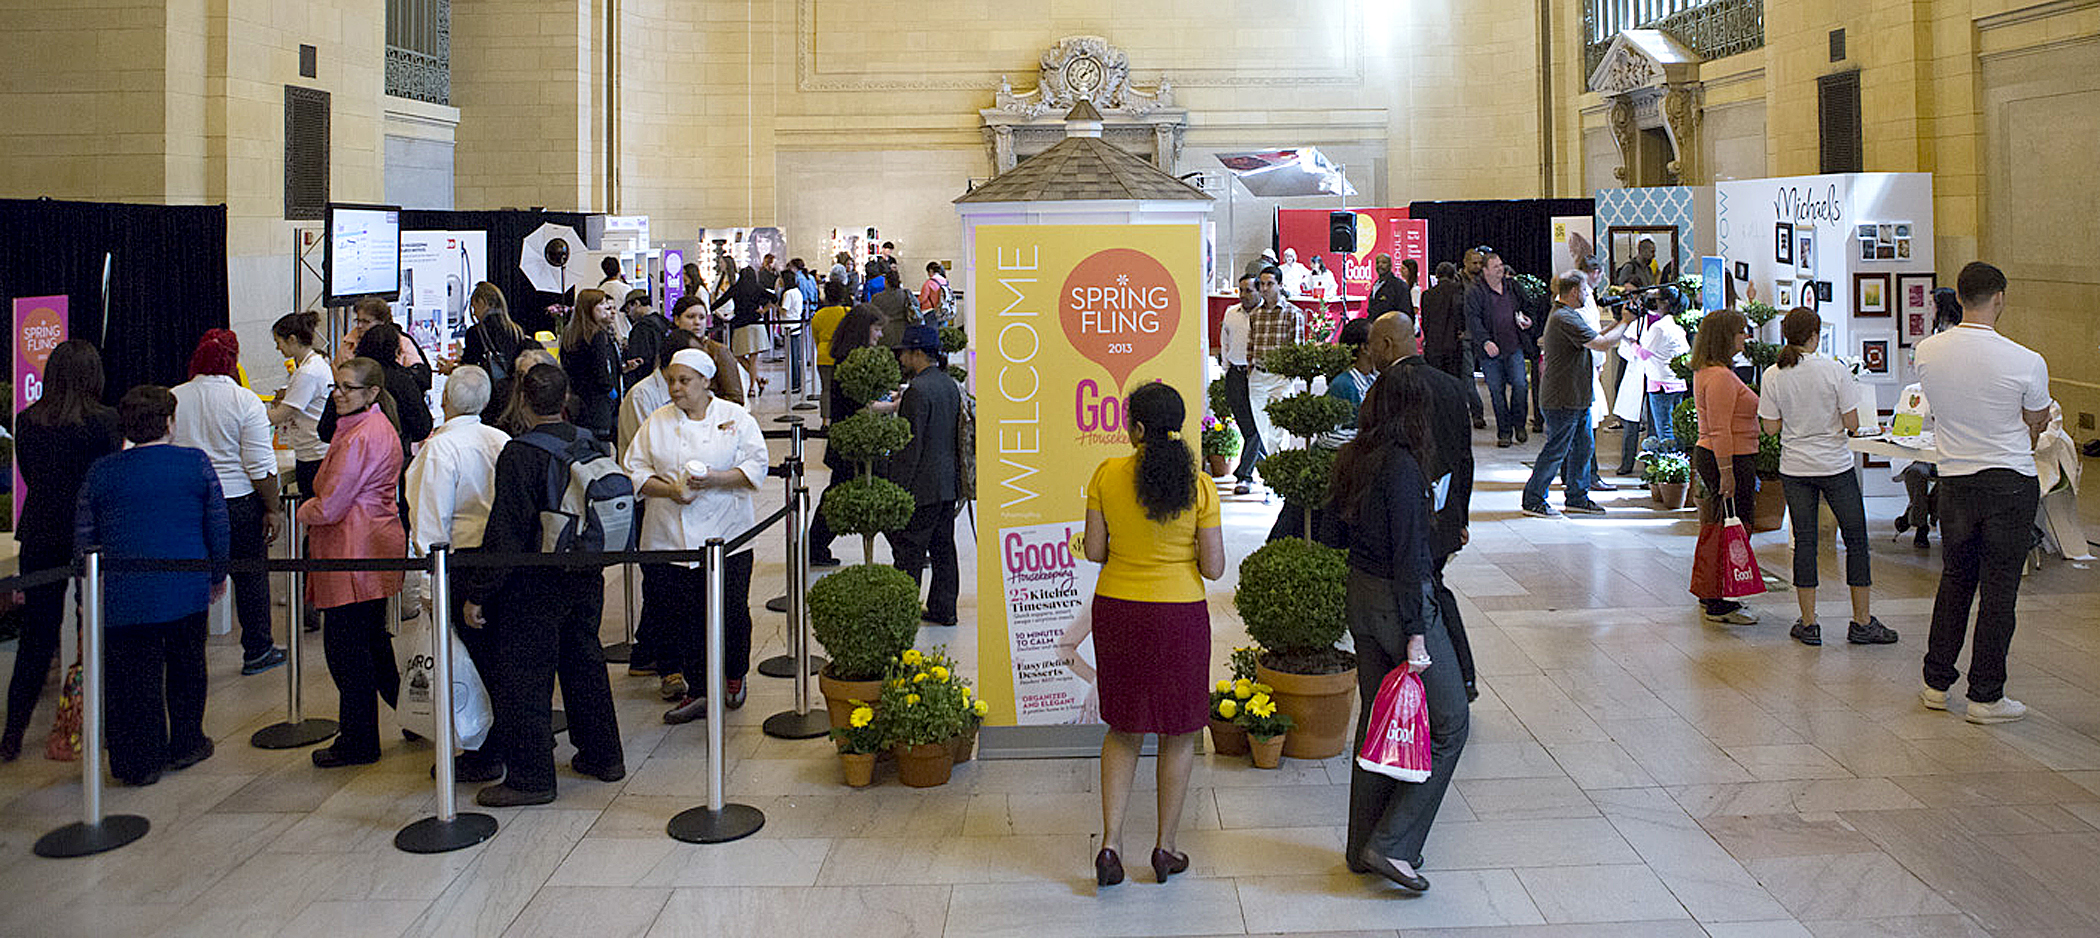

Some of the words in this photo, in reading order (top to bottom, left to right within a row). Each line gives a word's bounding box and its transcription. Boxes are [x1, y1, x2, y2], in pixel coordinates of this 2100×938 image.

[1773, 184, 1841, 227] Michaels
[1345, 259, 1372, 280] Good
[1071, 286, 1169, 310] SPRING
[1081, 311, 1159, 334] FLING
[24, 324, 60, 340] SPRING
[27, 337, 58, 351] FLING
[1108, 343, 1133, 354] 2013
[998, 245, 1039, 508] WELCOME
[25, 373, 43, 401] Go
[1005, 527, 1076, 573] Good
[1007, 567, 1078, 591] Housekeeping
[1733, 565, 1754, 582] Good
[1009, 588, 1029, 602] 25
[1030, 587, 1078, 600] Kitchen
[1013, 598, 1083, 612] Timesavers
[1027, 628, 1065, 638] MINUTES
[1016, 639, 1028, 647] TO
[1030, 637, 1054, 645] CALM
[1017, 661, 1042, 672] Easy
[1019, 668, 1064, 680] Desserts
[1022, 692, 1068, 702] ORGANIZED
[1023, 701, 1040, 709] AND
[1041, 697, 1076, 708] ELEGANT
[1386, 719, 1416, 745] Good
